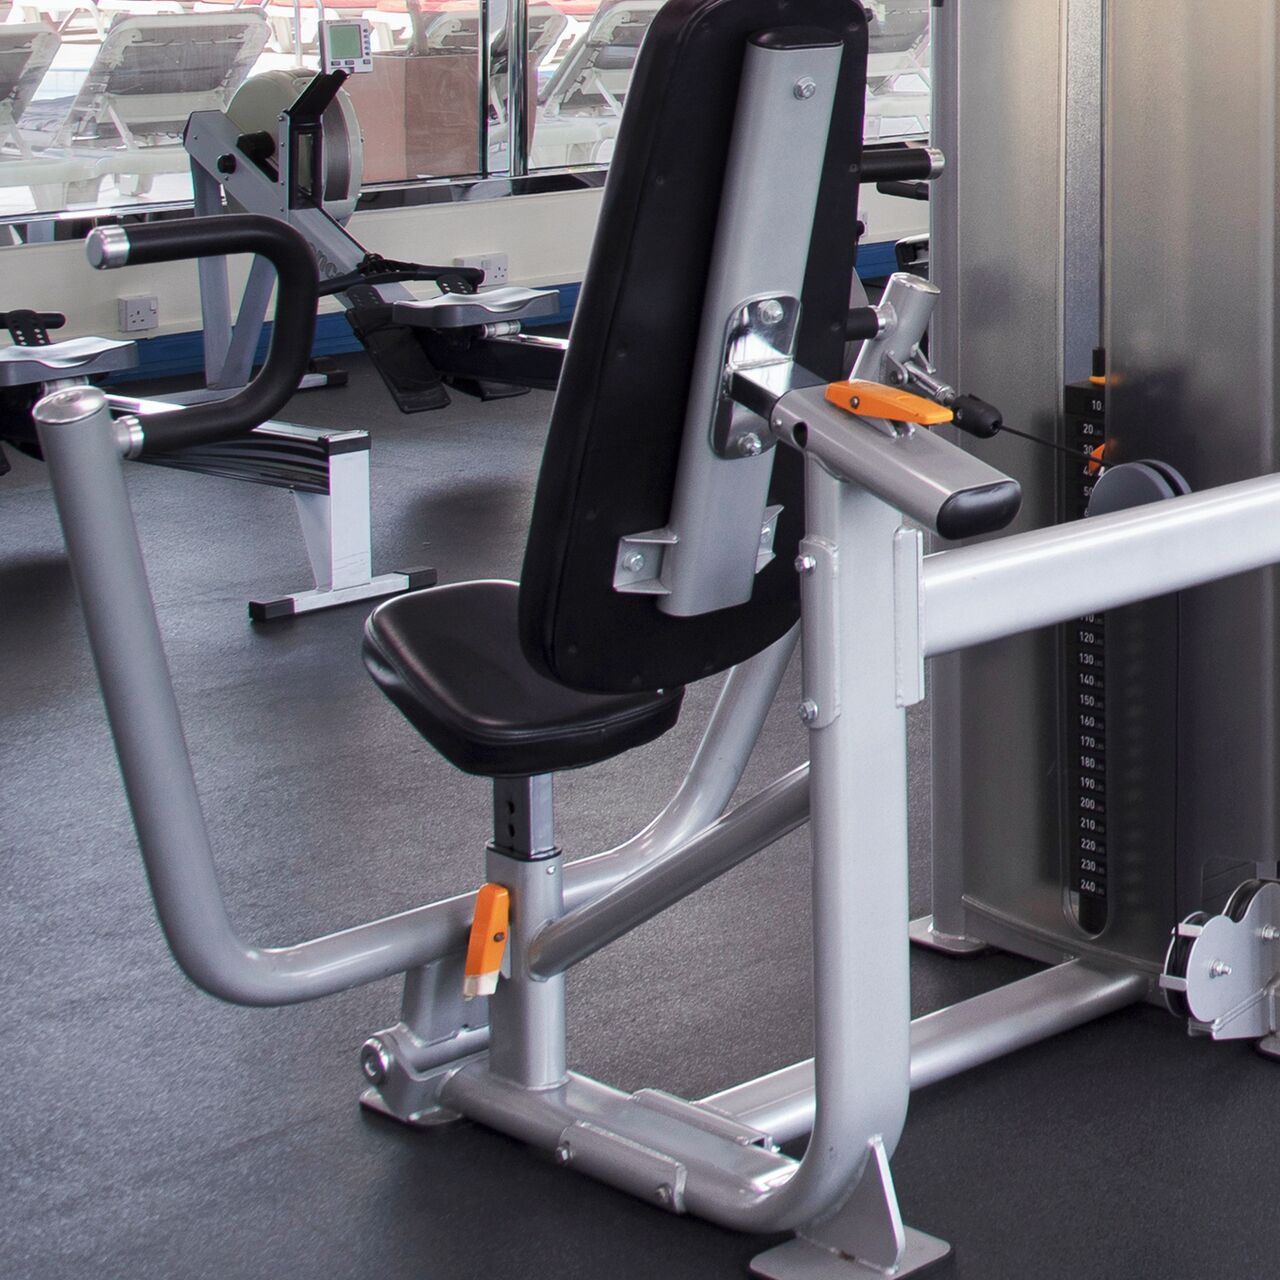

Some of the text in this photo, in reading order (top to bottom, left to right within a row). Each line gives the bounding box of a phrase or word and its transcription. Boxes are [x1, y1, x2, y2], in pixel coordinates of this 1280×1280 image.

[1092, 400, 1102, 411] 10
[1083, 424, 1093, 435] 20
[1080, 631, 1094, 644] 120
[1080, 653, 1094, 665] 130
[1080, 673, 1094, 686] 140
[1080, 694, 1095, 707] 150
[1080, 715, 1095, 727] 160
[1081, 736, 1095, 748] 170
[1080, 756, 1095, 768] 180
[1081, 777, 1095, 789] 190
[1080, 797, 1095, 810] 200
[1081, 817, 1095, 830] 210
[1081, 838, 1096, 851] 220
[1081, 859, 1096, 871] 230
[1081, 880, 1096, 892] 240
